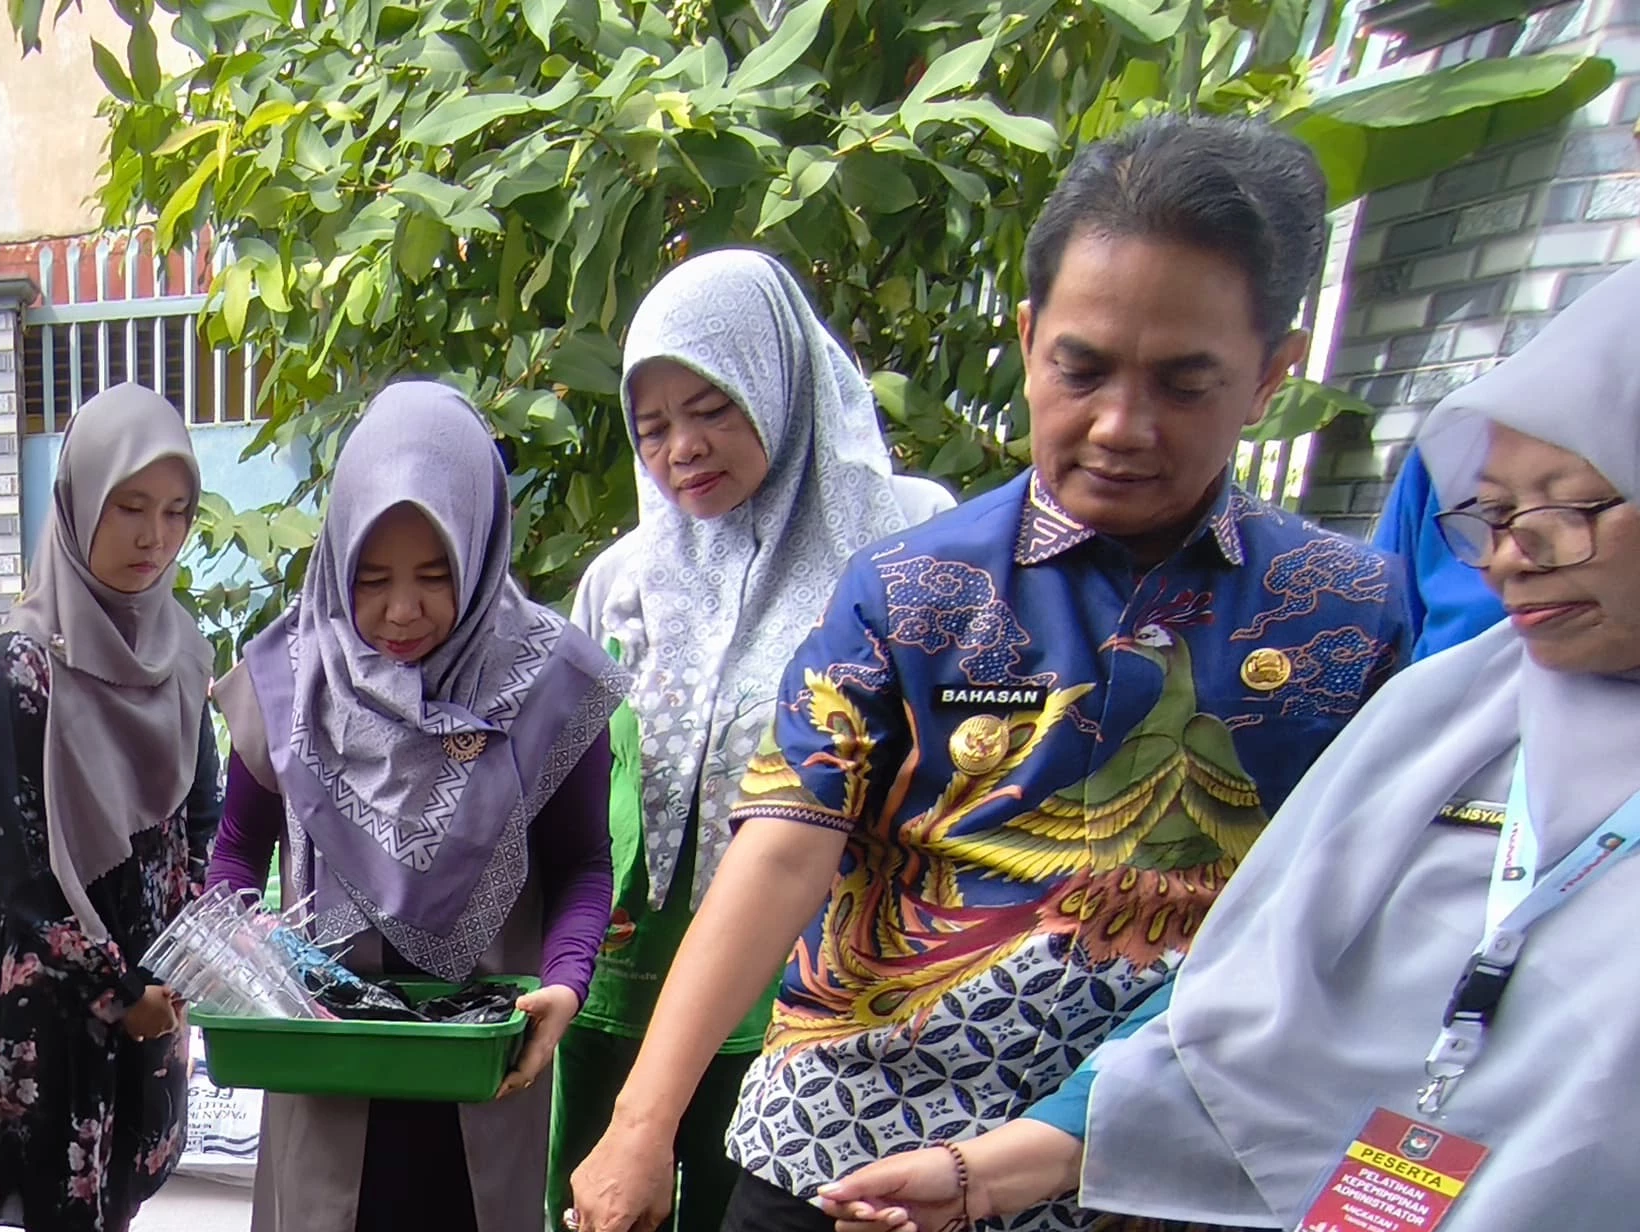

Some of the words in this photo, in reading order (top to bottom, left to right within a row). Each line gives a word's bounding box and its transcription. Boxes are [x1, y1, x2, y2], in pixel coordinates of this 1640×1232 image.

[941, 690, 1038, 703] BAHASAN
[1359, 1168, 1426, 1200] PELATIHAN
[1360, 1148, 1443, 1188] PESERTA
[1332, 1184, 1425, 1226] ADMINISTRATOR
[1342, 1174, 1430, 1216] KEPEMIMPINAN
